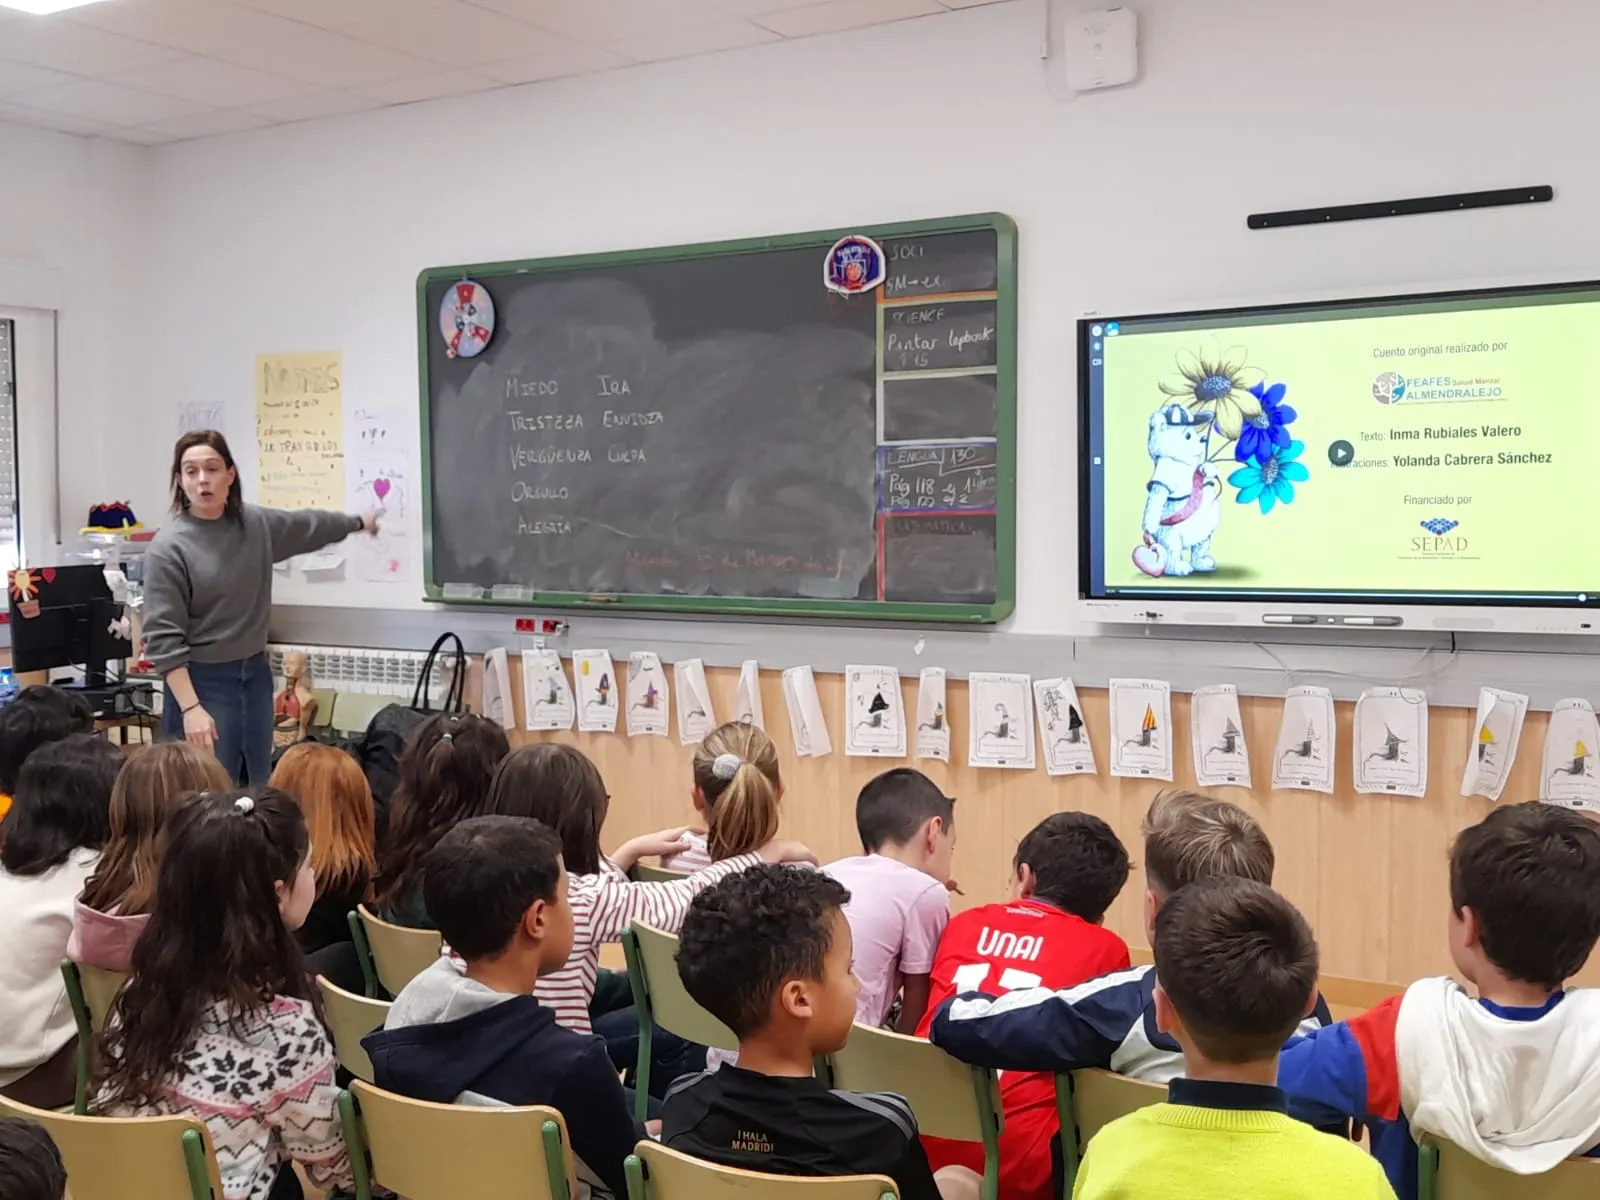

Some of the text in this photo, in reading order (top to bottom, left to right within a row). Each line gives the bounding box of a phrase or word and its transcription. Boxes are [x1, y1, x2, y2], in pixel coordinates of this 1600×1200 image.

[1373, 341, 1509, 358] Cuento original realizado por
[506, 375, 631, 397] MIEDO IRA
[1406, 377, 1451, 387] FEAFES
[1406, 387, 1502, 400] ALMENDRALEJO
[506, 410, 663, 431] TRISTEZA ENVIDIA
[1360, 424, 1521, 442] Texto: Inma Rubiales Valero
[510, 445, 592, 470] VERGÜENZA
[1393, 454, 1440, 467] Yolanda
[1444, 453, 1494, 466] Cabrera
[1497, 452, 1552, 465] Sánchez
[511, 481, 568, 502] ORGULLO
[1404, 495, 1472, 507] Financiado por
[1410, 536, 1469, 552] SEPAD
[976, 926, 1044, 961] UNAI
